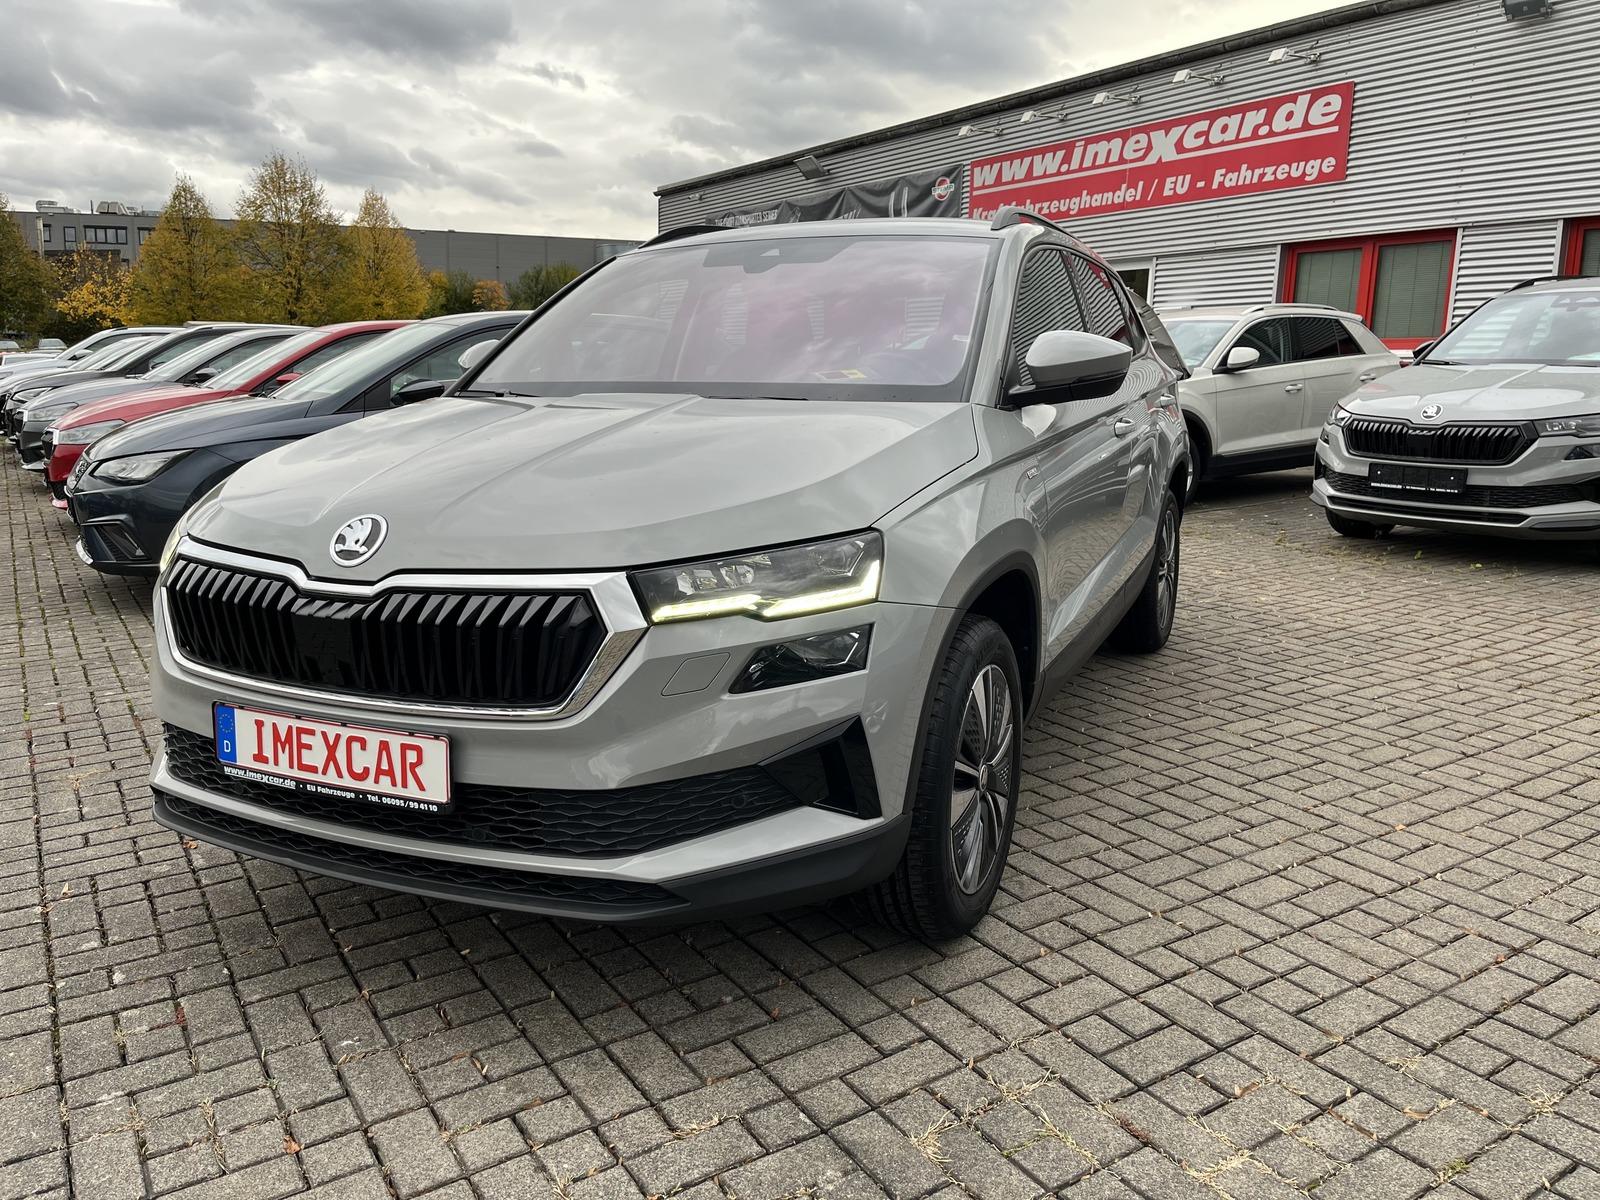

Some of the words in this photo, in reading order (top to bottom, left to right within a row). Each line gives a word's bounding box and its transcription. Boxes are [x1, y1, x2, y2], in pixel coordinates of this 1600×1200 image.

[973, 93, 1343, 188] www.imexcar.de
[1163, 174, 1192, 197] EU
[1212, 156, 1337, 192] Fahrzeuge
[223, 740, 231, 753] D
[252, 718, 427, 792] IMEXCAR
[223, 765, 297, 790] www.imexcar.de
[306, 784, 316, 792] EU
[317, 786, 356, 799] Fahrzeuge
[366, 794, 381, 803] Tel.
